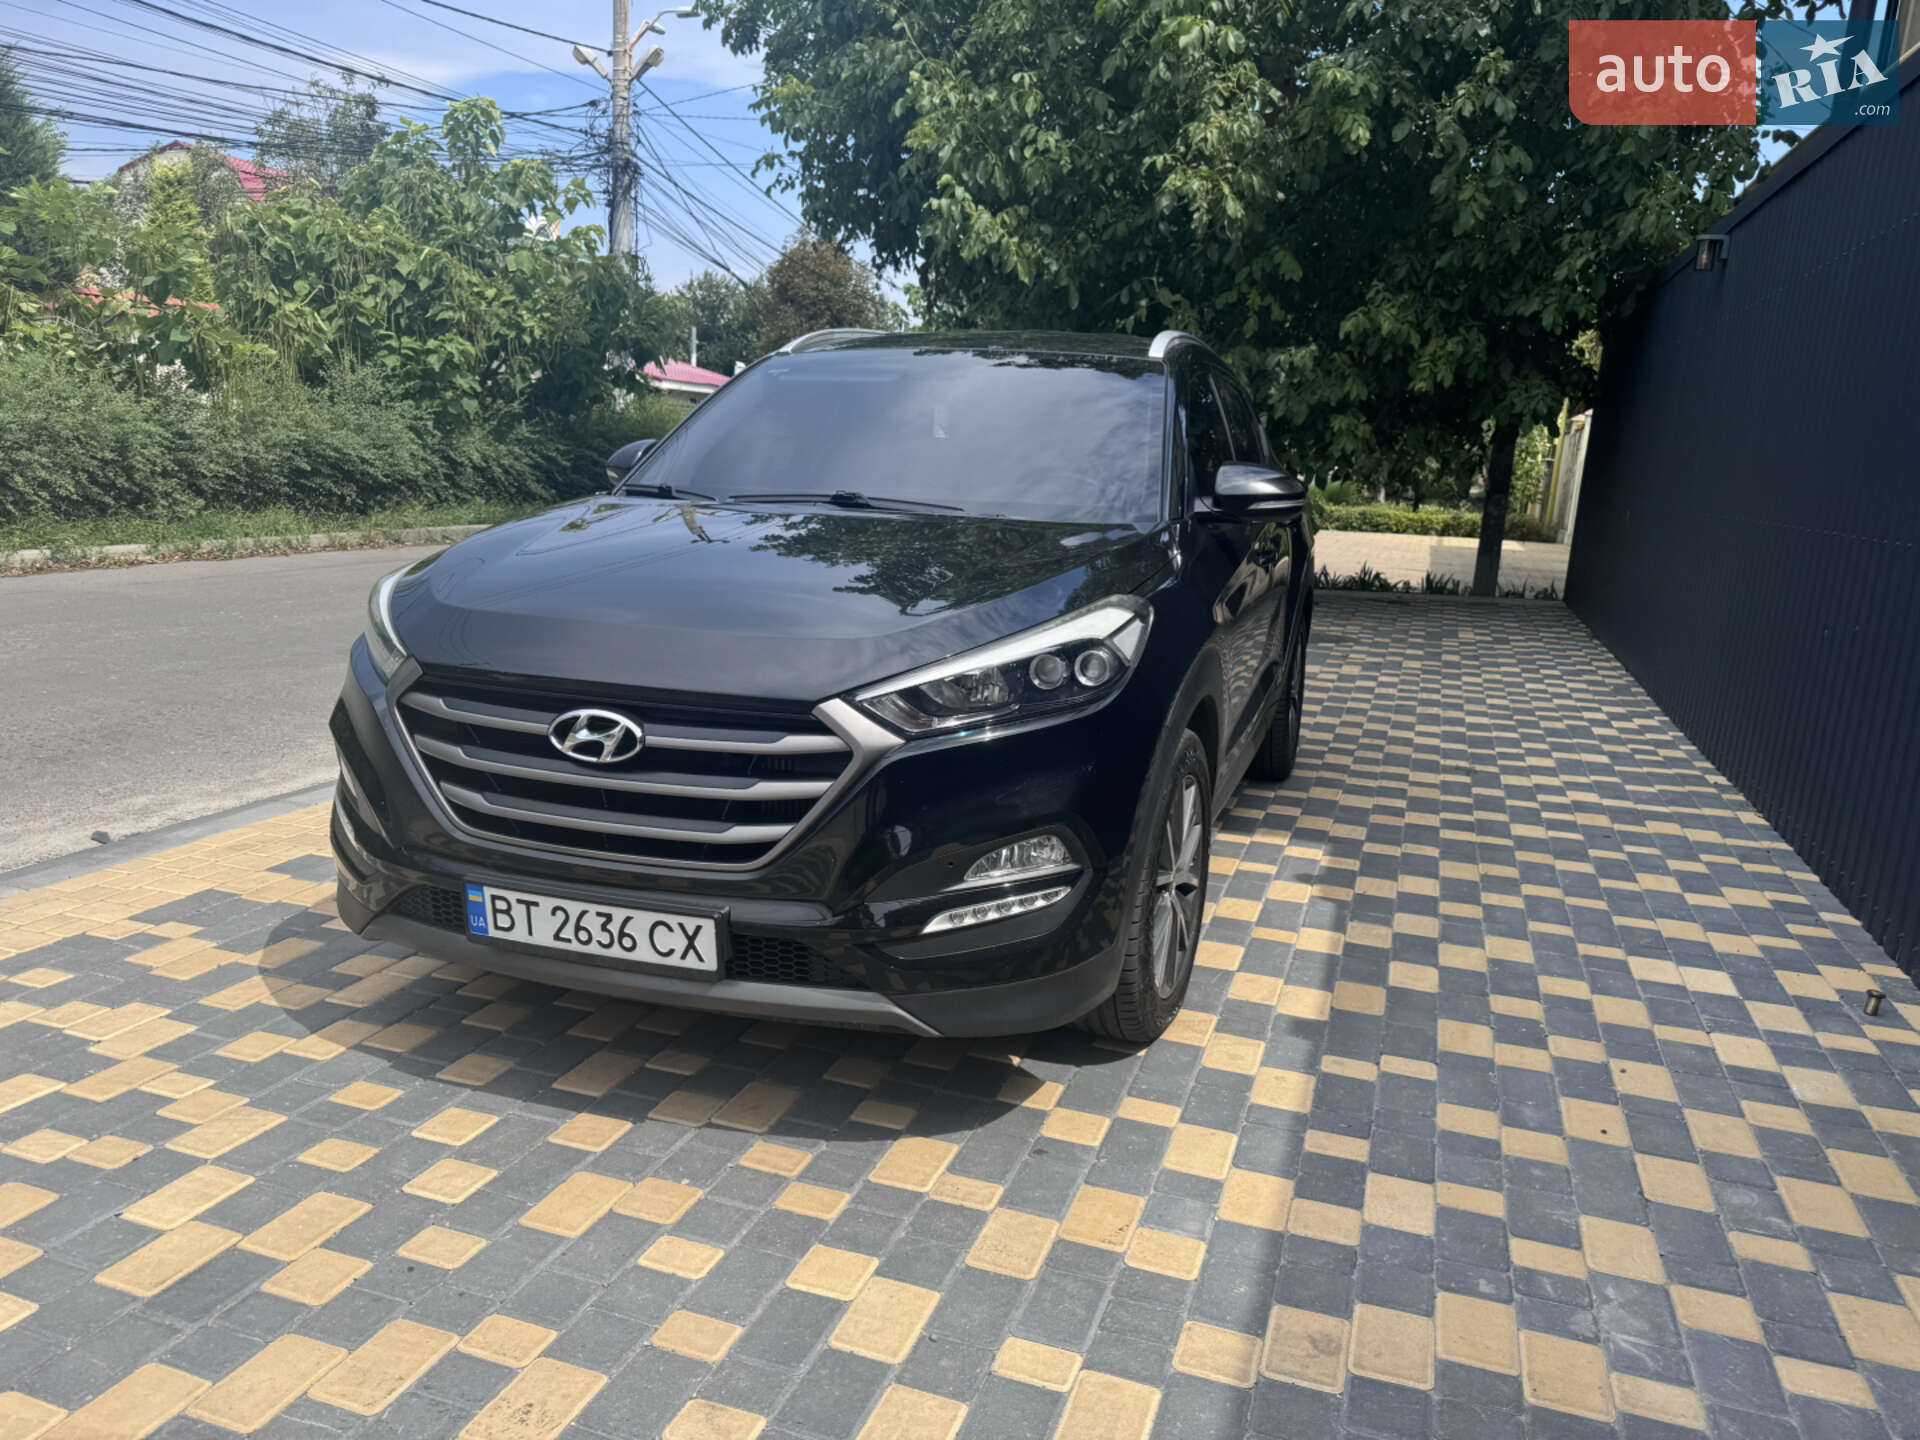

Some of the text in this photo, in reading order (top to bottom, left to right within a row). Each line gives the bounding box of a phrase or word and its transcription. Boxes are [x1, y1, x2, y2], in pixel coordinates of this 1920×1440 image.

[470, 914, 486, 928] UA
[490, 894, 705, 963] BT 2636 CX
